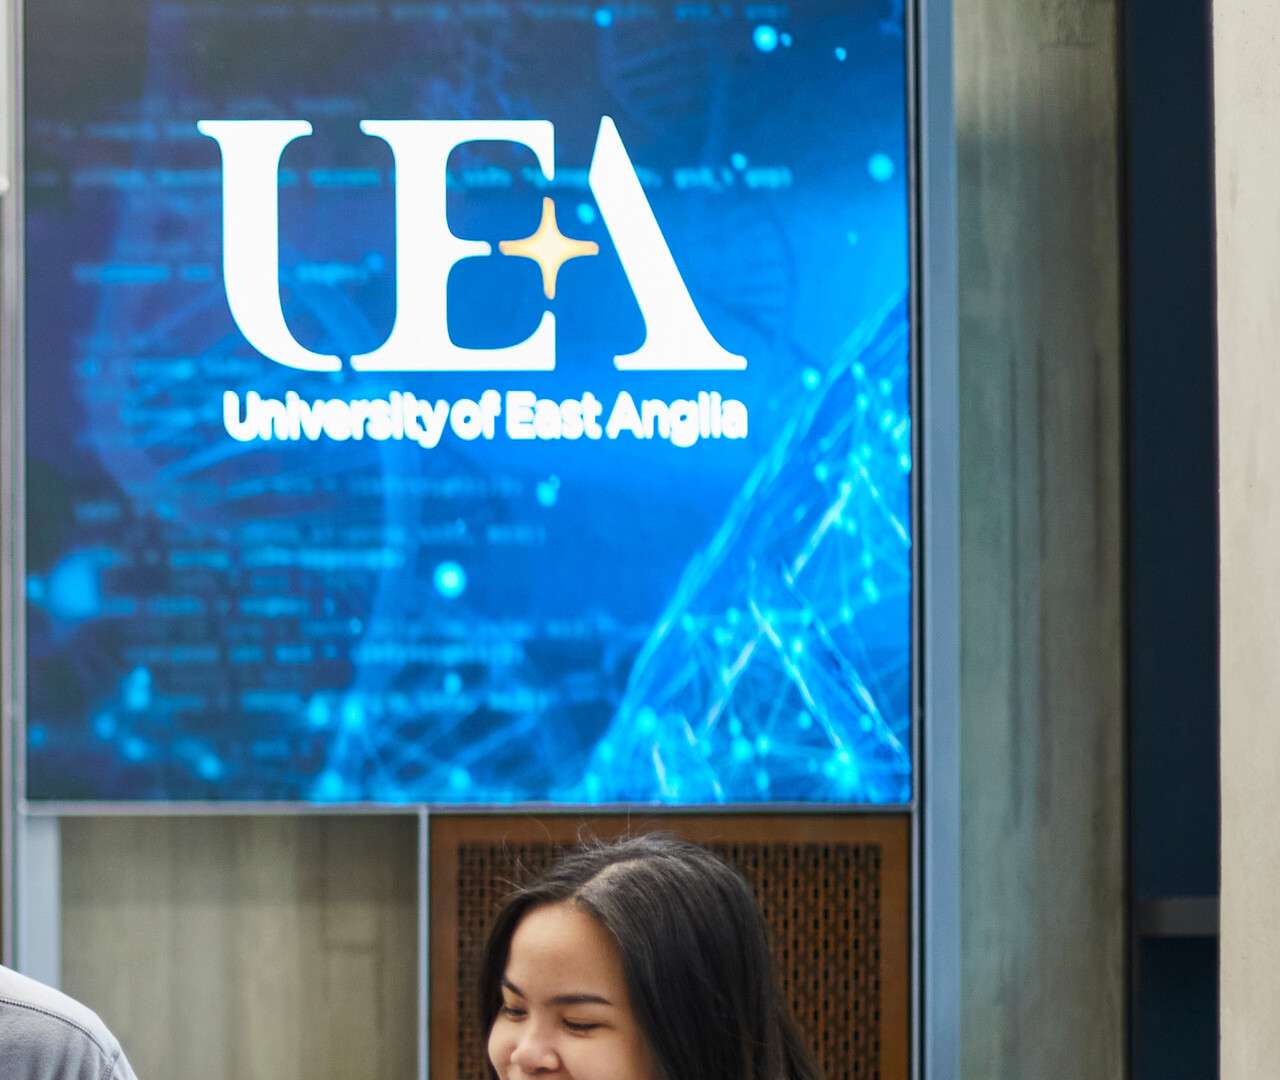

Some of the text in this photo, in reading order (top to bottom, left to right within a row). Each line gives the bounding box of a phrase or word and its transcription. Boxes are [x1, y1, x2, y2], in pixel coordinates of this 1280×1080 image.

[196, 115, 748, 372] UEA
[223, 389, 749, 449] University of East Anglia
